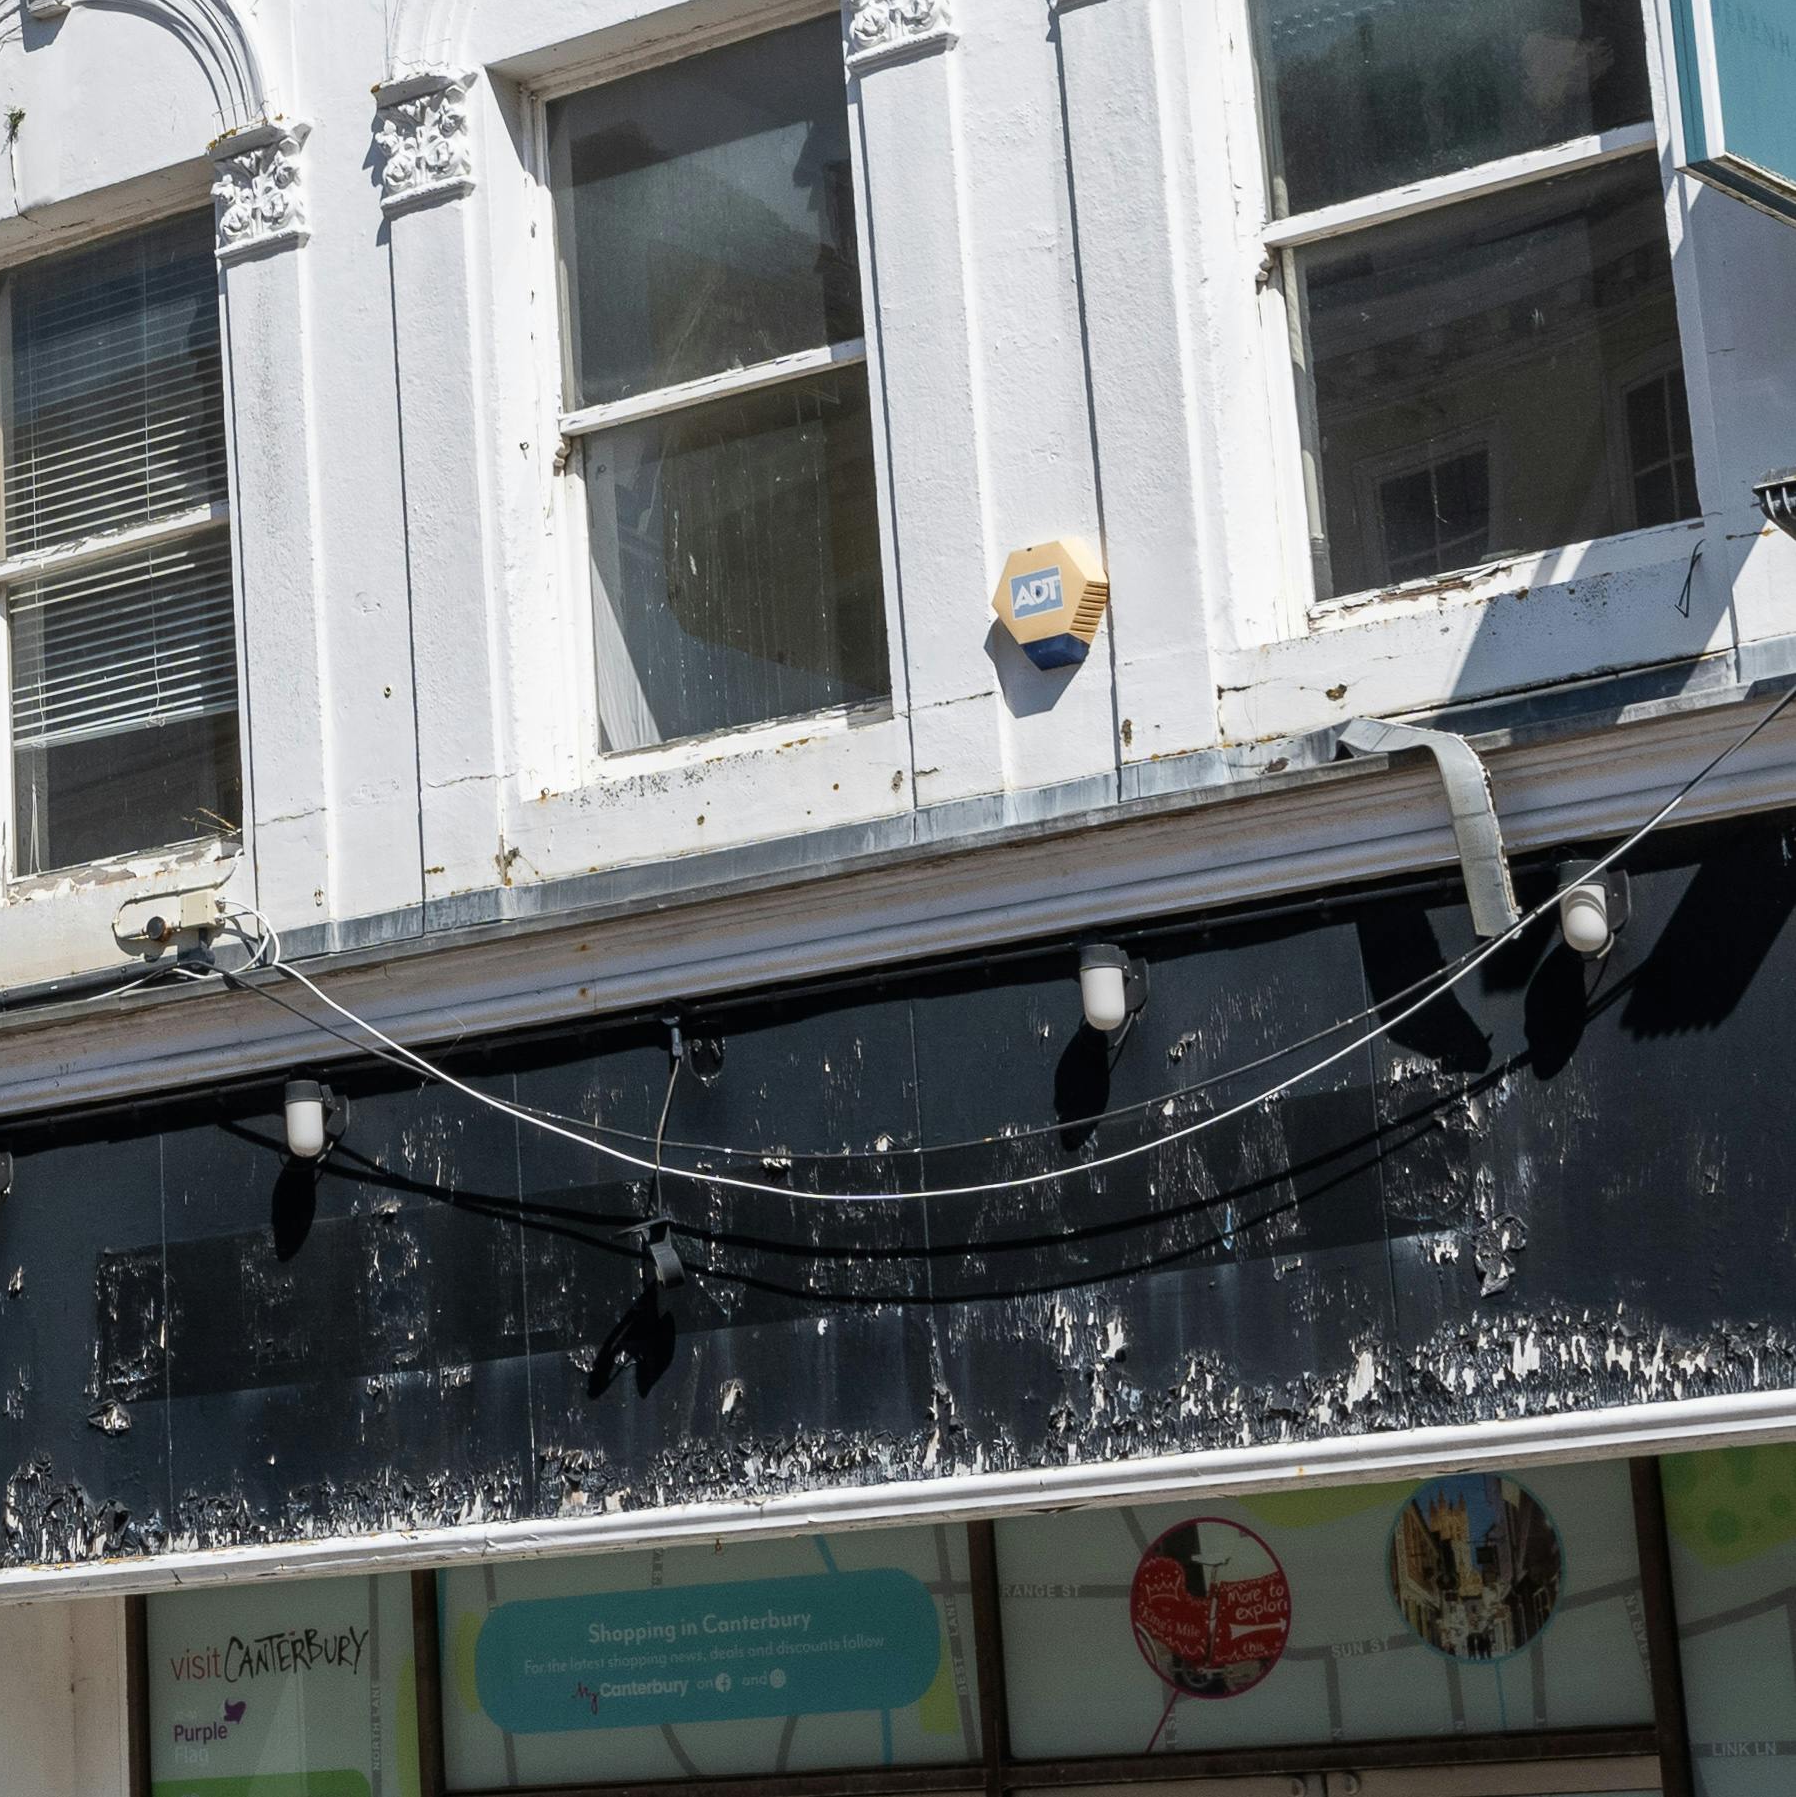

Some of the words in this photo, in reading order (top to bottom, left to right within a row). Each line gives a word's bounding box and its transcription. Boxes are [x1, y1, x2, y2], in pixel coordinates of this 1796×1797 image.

[1014, 575, 1060, 610] ADT
[1001, 1584, 1056, 1598] RANGE
[1061, 1583, 1081, 1598] ST
[1227, 1588, 1262, 1606] More
[1269, 1581, 1285, 1598] to
[588, 1623, 676, 1646] Shopping
[680, 1618, 698, 1636] in
[701, 1609, 812, 1635] Canterbury
[945, 1595, 959, 1637] LANE
[170, 1645, 222, 1681] visit
[223, 1625, 369, 1683] CANTERBURY
[524, 1658, 543, 1675] For
[548, 1657, 567, 1673] the
[570, 1655, 604, 1672] latest
[608, 1652, 667, 1671] shopping
[710, 1644, 745, 1660] deals
[748, 1641, 773, 1658] and
[775, 1638, 840, 1656] discounts
[842, 1634, 885, 1650] follow
[1331, 1639, 1364, 1657] SUN
[1369, 1636, 1390, 1653] ST
[599, 1678, 689, 1699] Canterbury
[696, 1678, 713, 1690] on
[742, 1671, 768, 1687] and
[954, 1656, 967, 1696] BEST
[173, 1721, 228, 1745] Purple
[174, 1746, 210, 1768] Flag
[1711, 1741, 1750, 1756] LINK
[1754, 1741, 1777, 1756] LN
